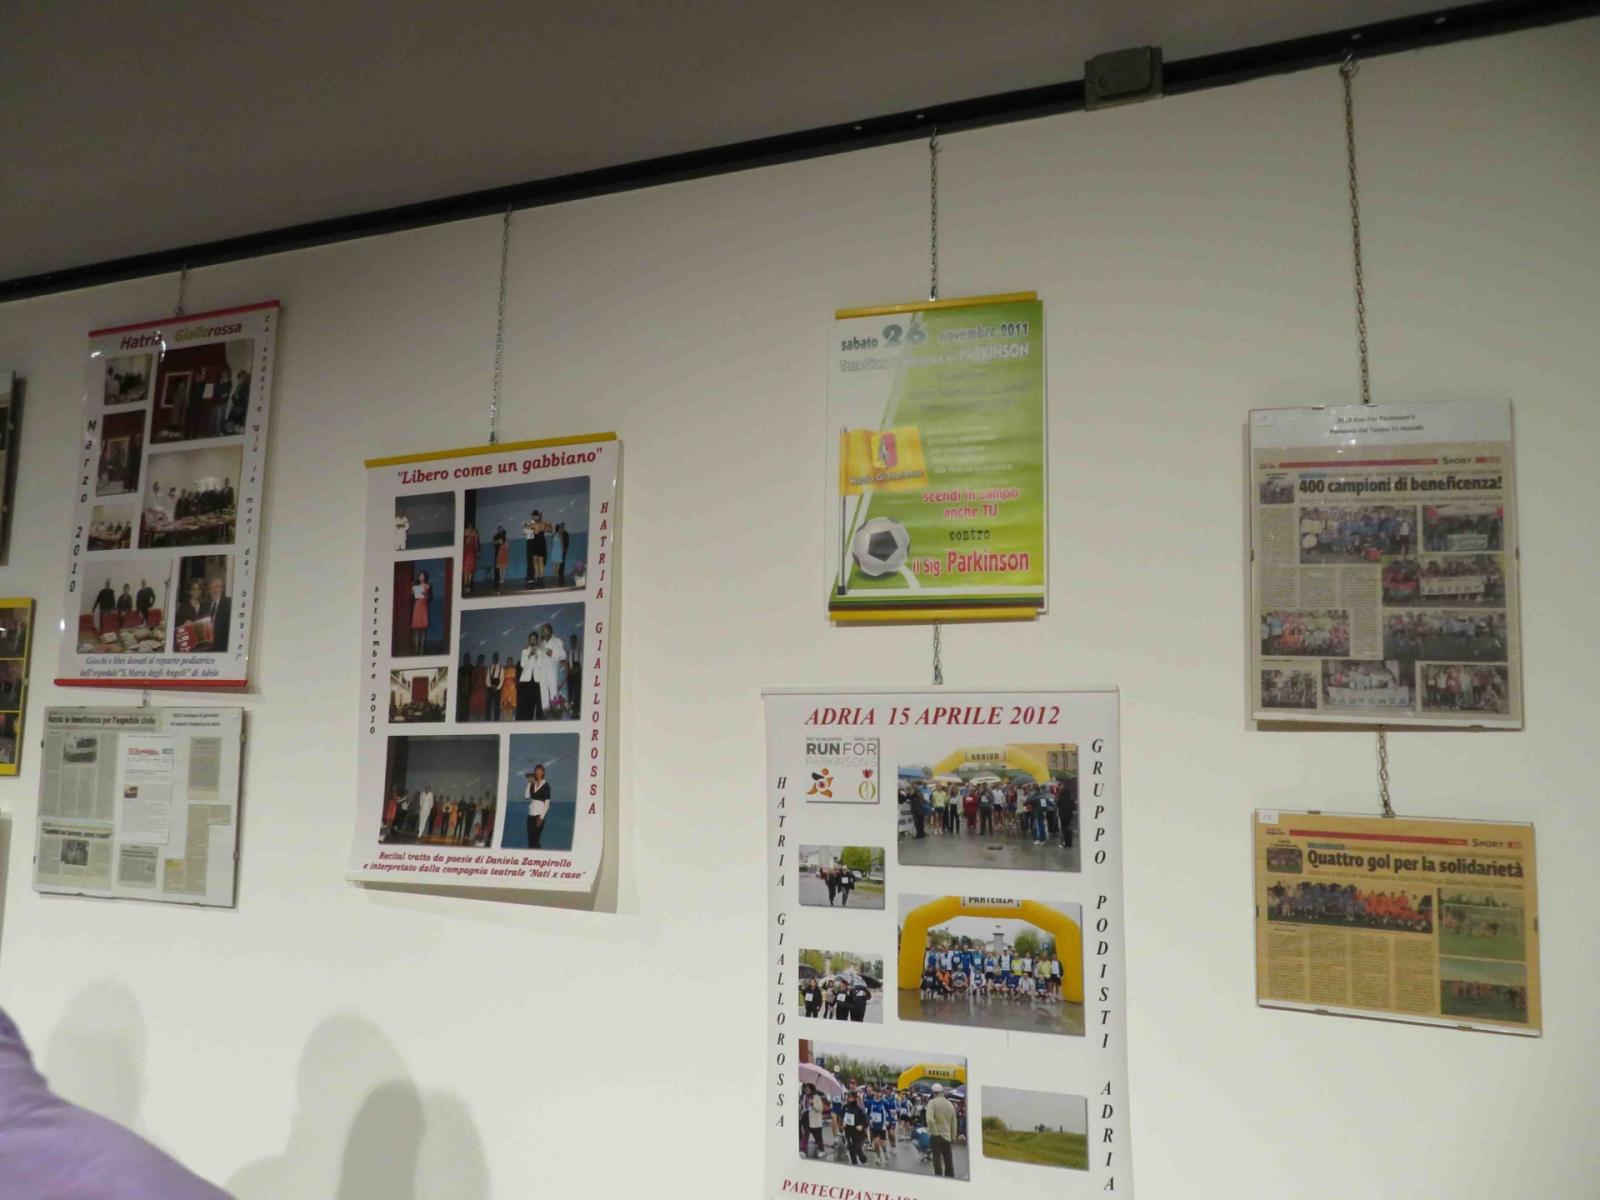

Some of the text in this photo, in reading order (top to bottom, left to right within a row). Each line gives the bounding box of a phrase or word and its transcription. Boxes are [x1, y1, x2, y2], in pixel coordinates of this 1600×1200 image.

[120, 322, 242, 350] Hatria Giallorossa
[840, 322, 1029, 352] sabato 26 novembre 2011
[959, 343, 1029, 361] PARKINSON
[397, 447, 603, 485] "Libero come un gabbiano"
[923, 488, 1020, 503] scendi in campo
[1299, 475, 1502, 496] 400 campioni di beneficenza!
[69, 420, 97, 592] Marzo 2010
[944, 504, 998, 519] anche TU
[949, 528, 991, 541] contro
[912, 550, 1030, 577] il Sig. Parkinson
[369, 586, 380, 735] settembre 2010
[587, 502, 608, 815] HATRIA GIALLOROSSA
[804, 705, 1061, 726] ADRIA 15 APRILE 2012
[806, 742, 878, 756] RUN FOR
[369, 862, 418, 872] interpretato
[418, 864, 441, 873] dalla
[442, 866, 488, 876] compagnia
[490, 867, 526, 877] teatrale
[378, 851, 573, 868] Recital tratto da poesie di Daniela Zampirollo
[1307, 850, 1365, 869] Quattro
[1368, 854, 1391, 872] gol
[1394, 858, 1419, 874] per
[1421, 855, 1436, 872] la
[1438, 857, 1524, 879] solidarietà
[775, 776, 787, 1128] HATRIA GIALLOROSSA
[1091, 738, 1115, 1192] GRUPPO PODISTI ADRIA
